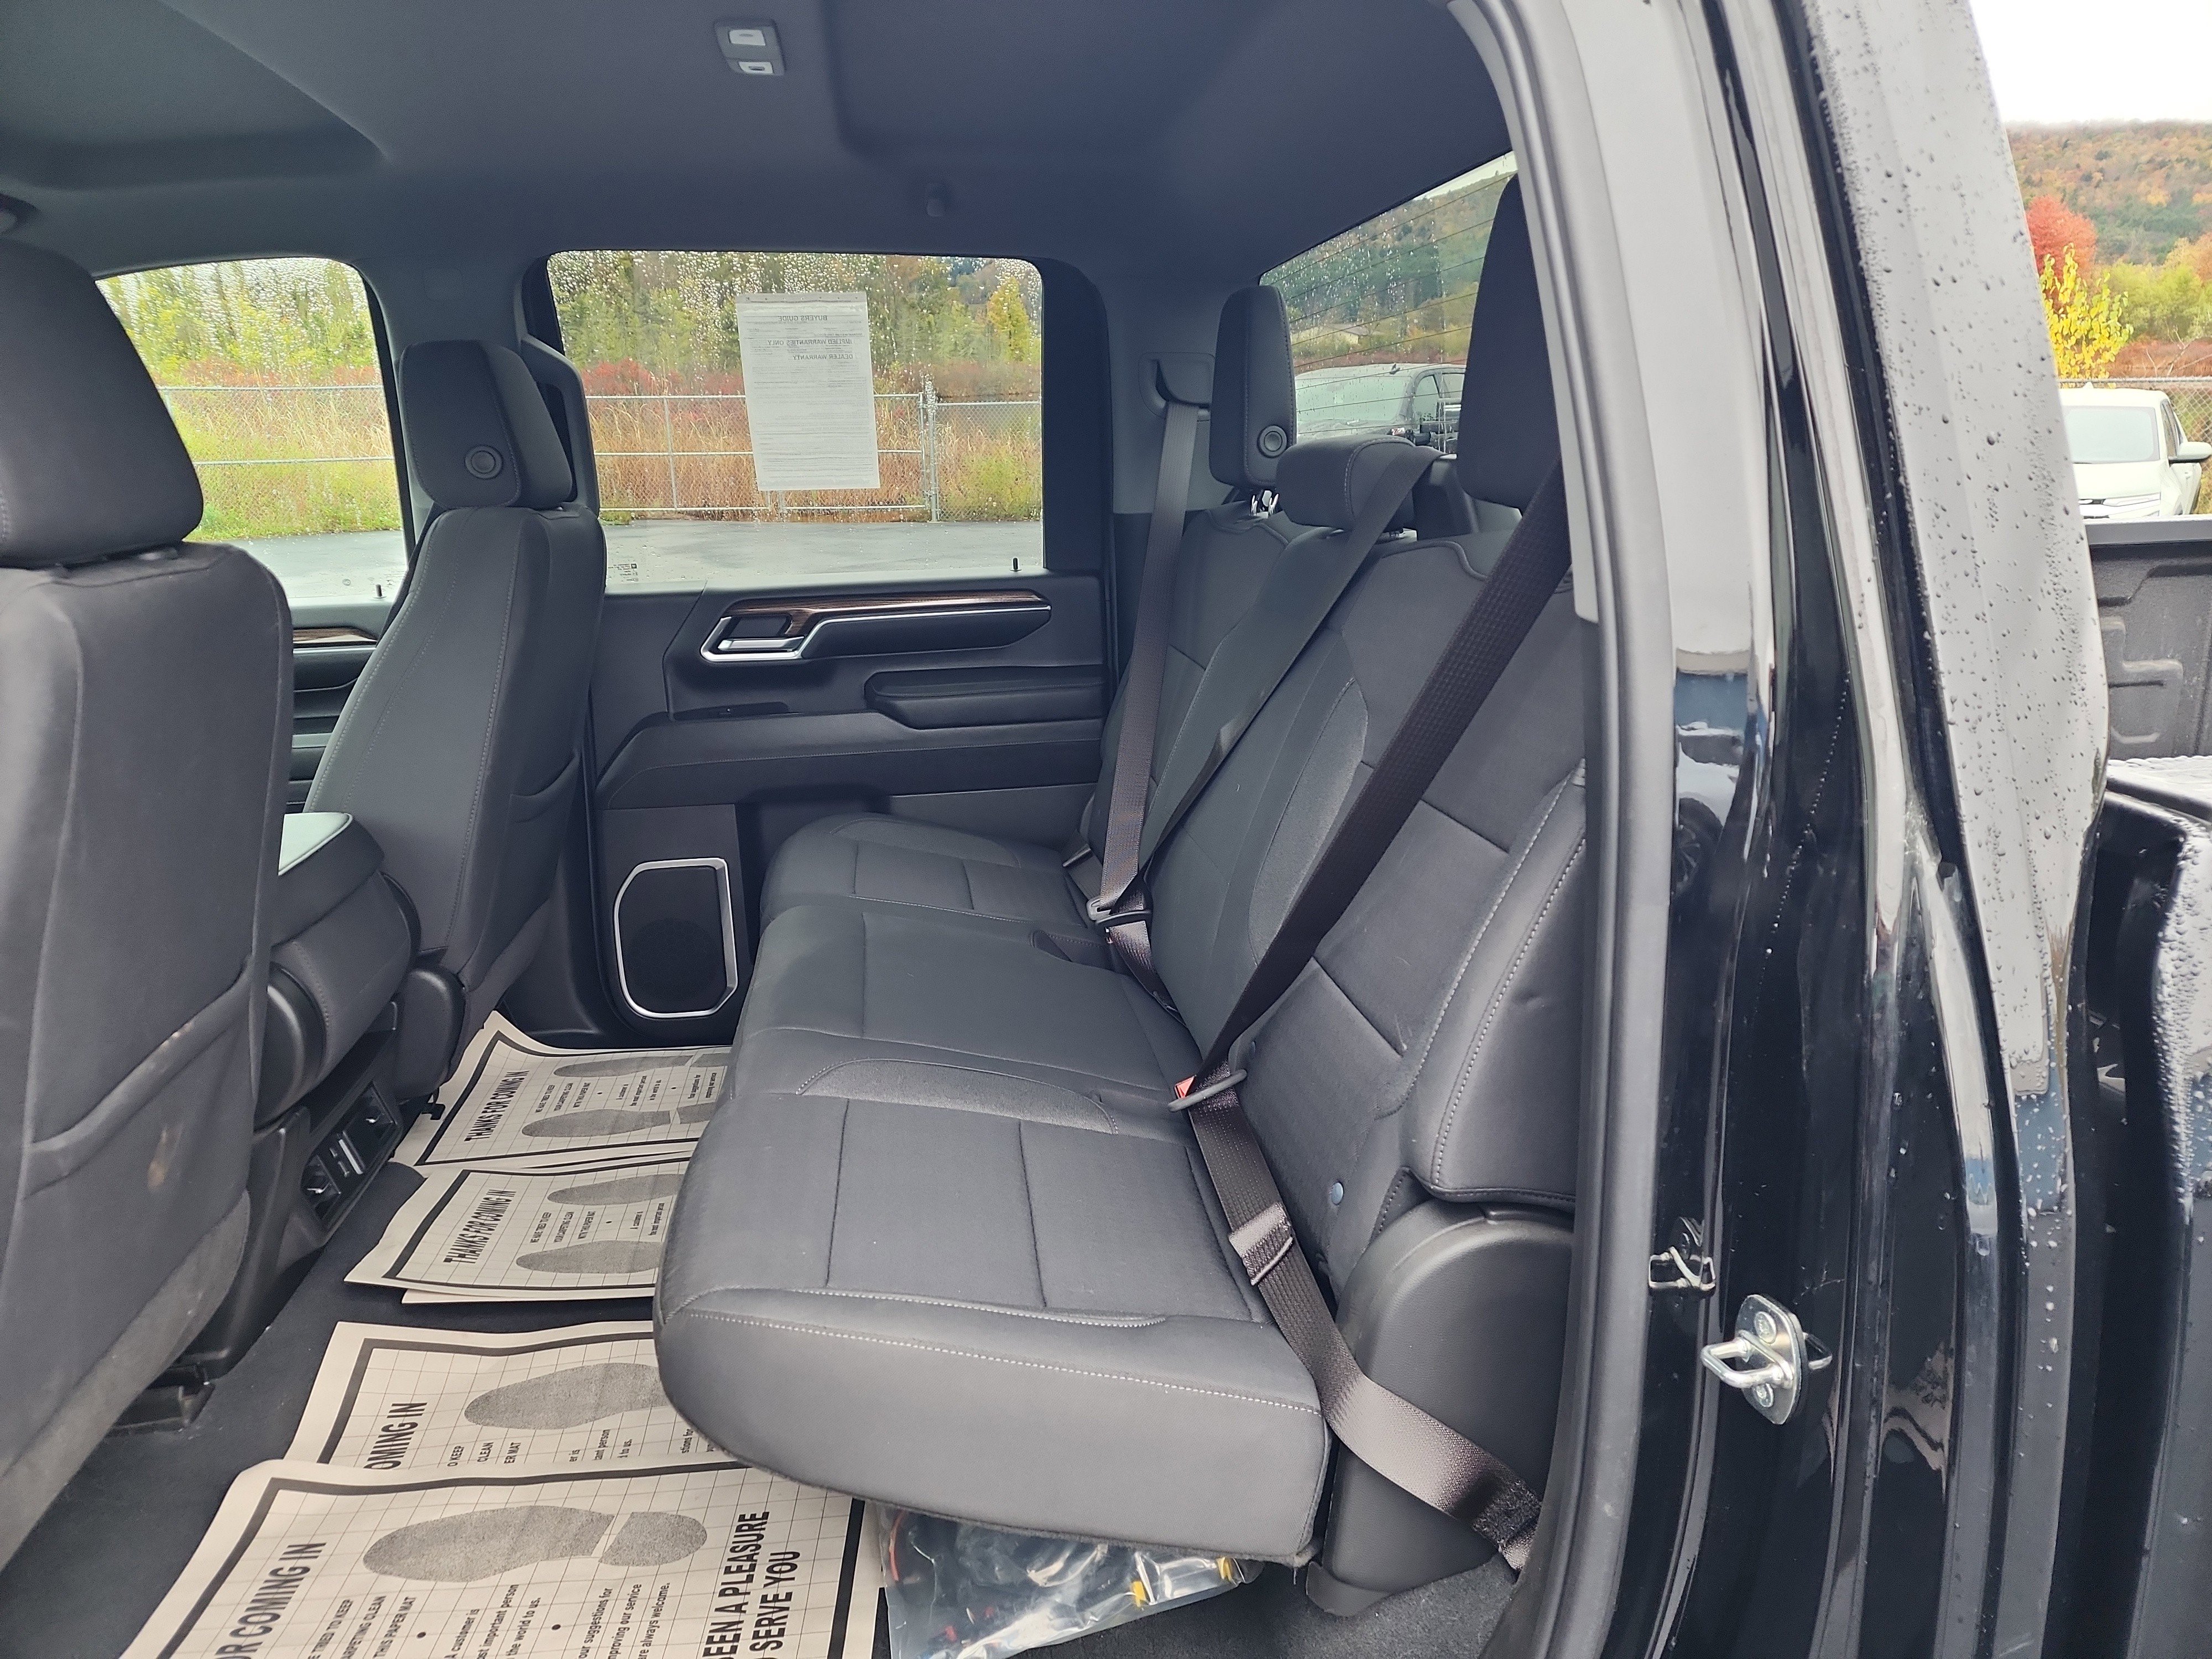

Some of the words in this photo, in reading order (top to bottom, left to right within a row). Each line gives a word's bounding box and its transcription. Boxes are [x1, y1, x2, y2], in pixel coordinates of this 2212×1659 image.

[490, 1077, 525, 1100] COMING
[481, 1099, 512, 1114] FOR
[464, 1114, 503, 1141] THANKS
[486, 1189, 517, 1197] IN
[471, 1197, 512, 1221] COMING
[462, 1220, 498, 1235] FOR
[443, 1234, 489, 1264] THANKS
[387, 1402, 427, 1418] IN
[363, 1422, 418, 1470] OMING
[508, 1442, 521, 1453] MAT
[598, 1429, 611, 1448] person
[449, 1445, 465, 1462] KEEP
[477, 1442, 494, 1463] CLEAN
[718, 1511, 770, 1598] PLEASURE
[763, 1551, 800, 1588] YOU
[229, 1566, 310, 1637] COMING
[279, 1542, 327, 1561] IN
[500, 1584, 519, 1608] person
[598, 1588, 613, 1599] for
[625, 1583, 642, 1610] service
[333, 1599, 354, 1619] KEEP
[620, 1612, 632, 1625] our
[640, 1619, 660, 1647] always
[651, 1582, 671, 1619] welcome.
[714, 1601, 749, 1614] A
[326, 1620, 342, 1631] TO
[341, 1622, 372, 1659] ARPETING
[363, 1595, 387, 1621] CLEAN
[372, 1639, 393, 1658] THIS
[384, 1612, 408, 1638] PAPER
[398, 1596, 417, 1611] MAT
[479, 1610, 508, 1647] important
[505, 1643, 521, 1656] the
[514, 1620, 532, 1642] world
[529, 1597, 541, 1608] us.
[584, 1599, 609, 1644] suggestions
[749, 1591, 793, 1652] SERVE
[451, 1617, 476, 1652] customer
[607, 1626, 630, 1659] mproving
[702, 1620, 744, 1659] EEN
[477, 1648, 489, 1659] ost
[578, 1646, 591, 1659] our
